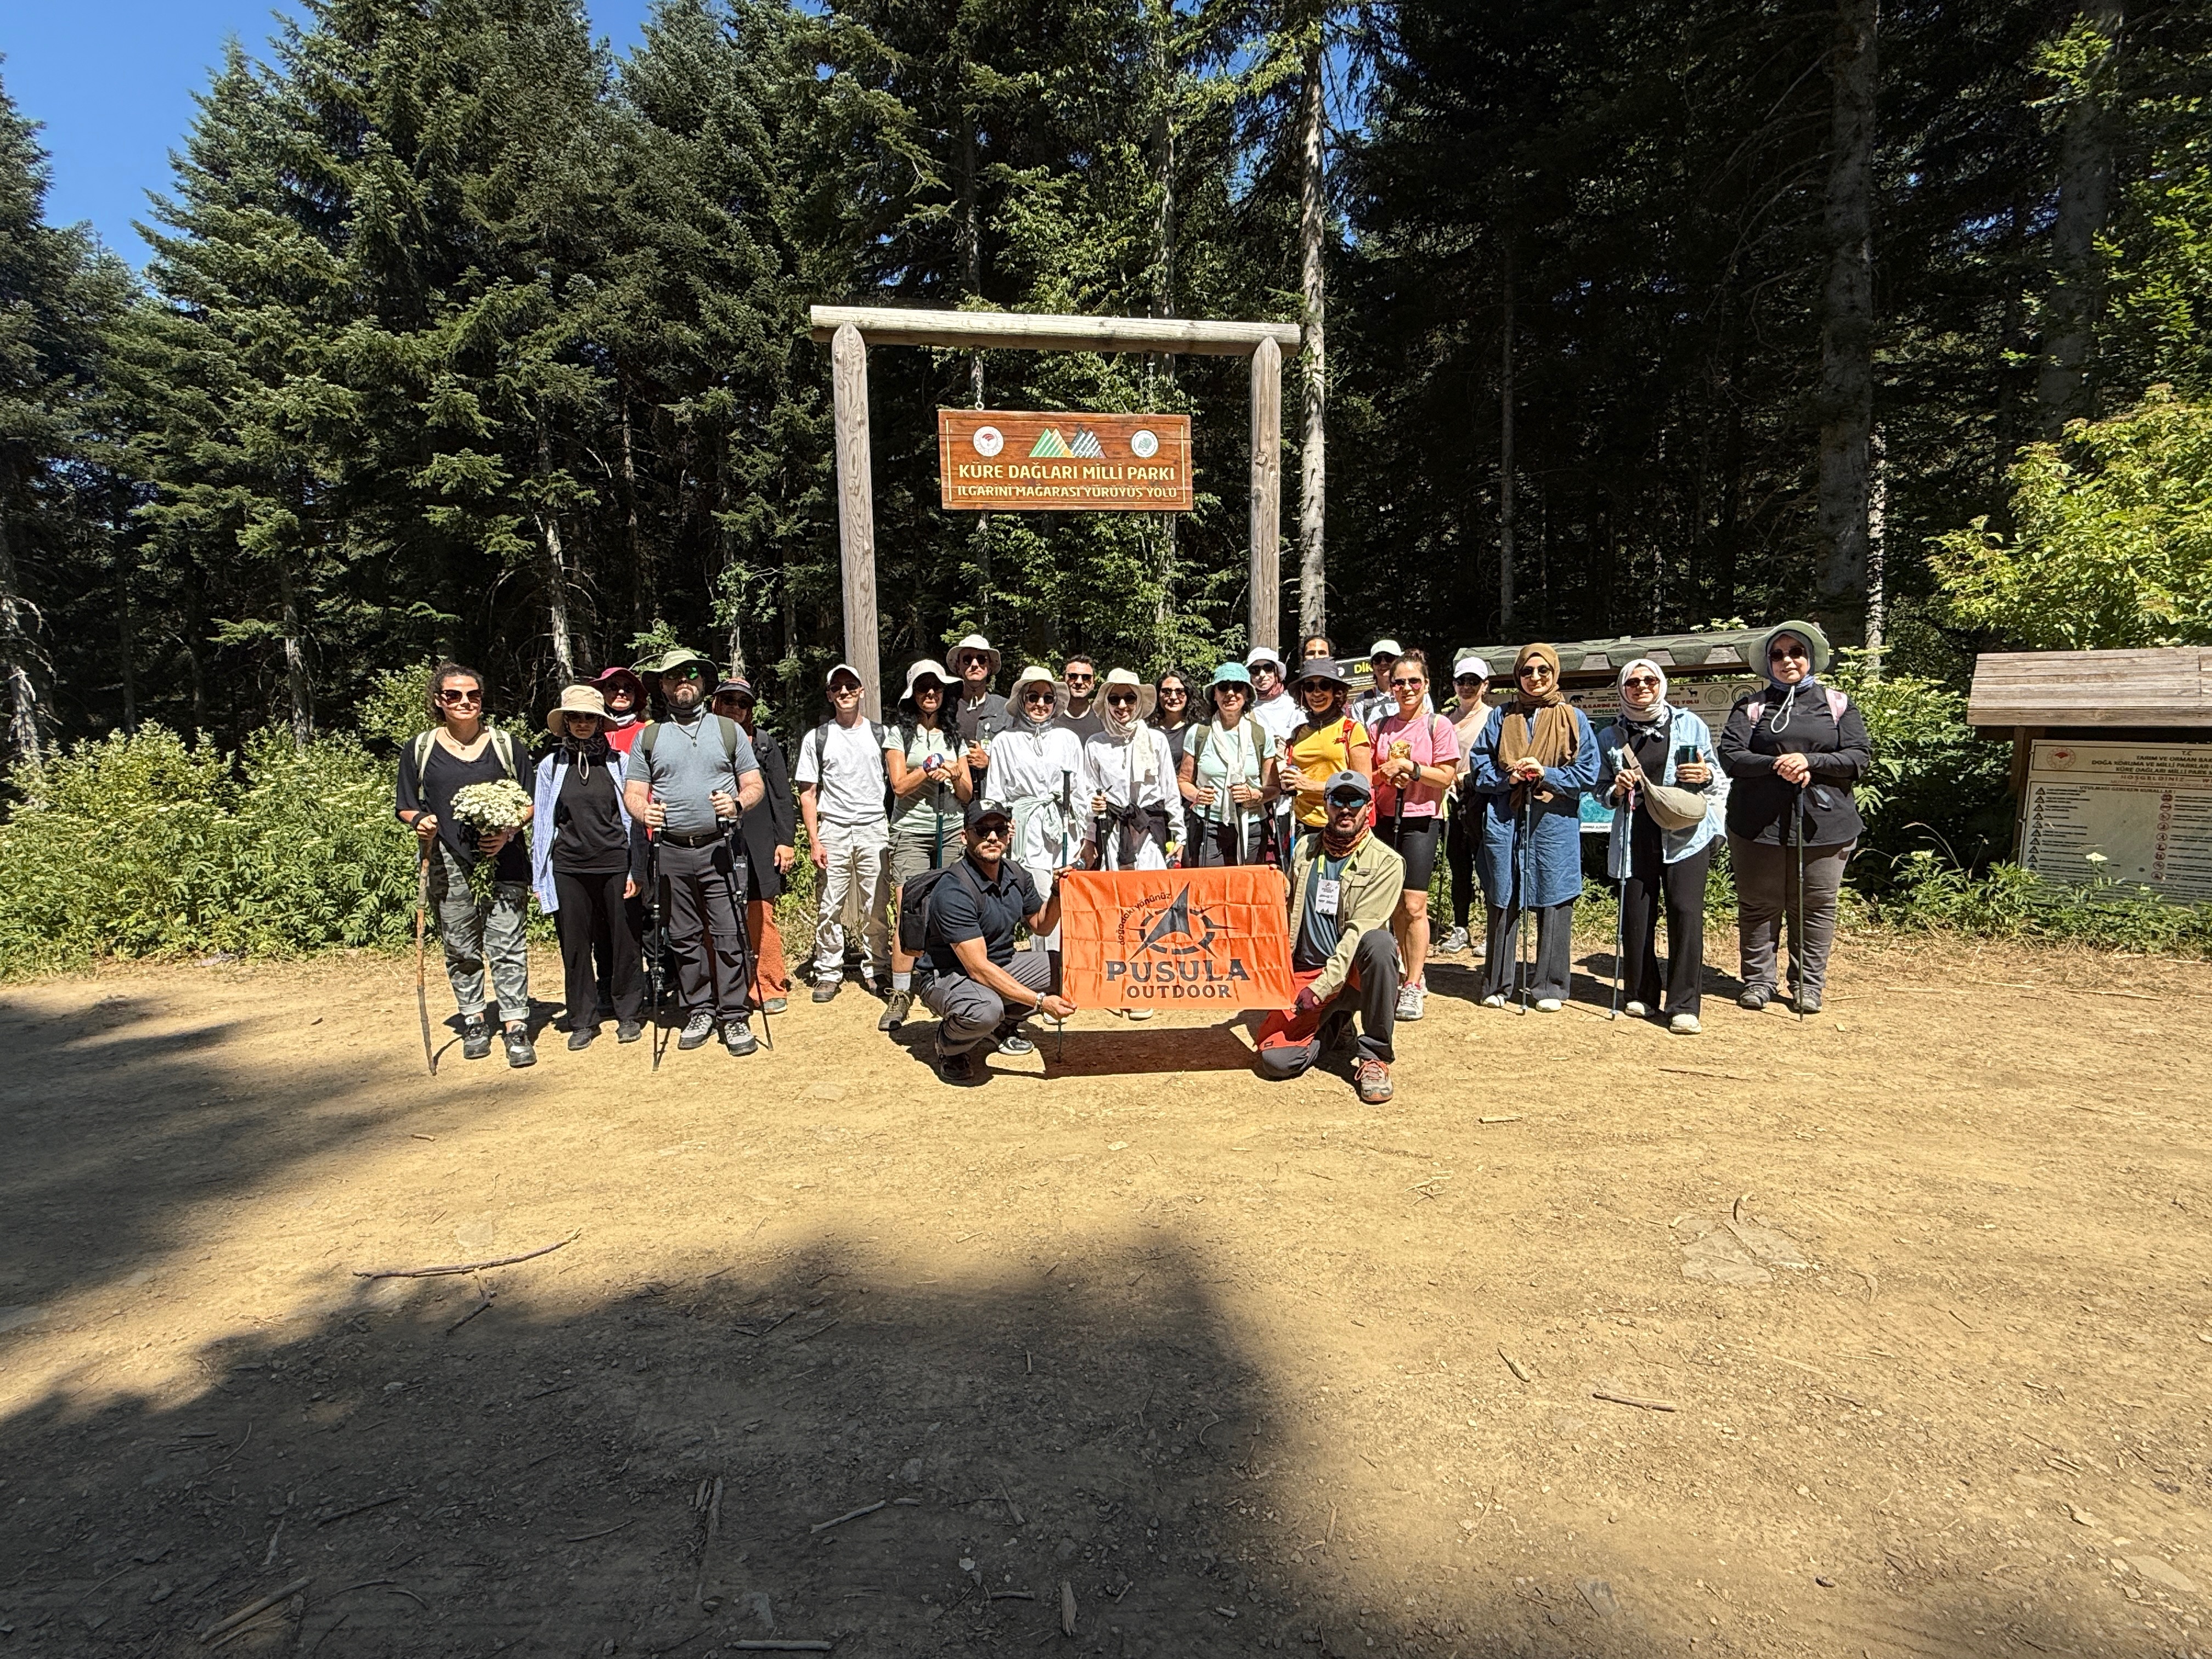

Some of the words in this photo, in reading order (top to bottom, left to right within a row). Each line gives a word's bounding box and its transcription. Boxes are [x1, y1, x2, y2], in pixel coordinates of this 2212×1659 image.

[959, 461, 1003, 479] KÜRE
[1008, 461, 1077, 480] DAĞLARI
[1082, 462, 1122, 481] MİLLİ
[1127, 466, 1175, 481] PARKI
[1015, 483, 1080, 498] MAĞARASI
[1084, 484, 1143, 500] YÜRÜYÜŞ
[1146, 487, 1177, 498] YOLU
[1354, 662, 1374, 674] DİK
[1134, 892, 1172, 911] yönünüz
[1105, 958, 1250, 983] PUSULA
[1126, 984, 1232, 998] OUTDOOR
